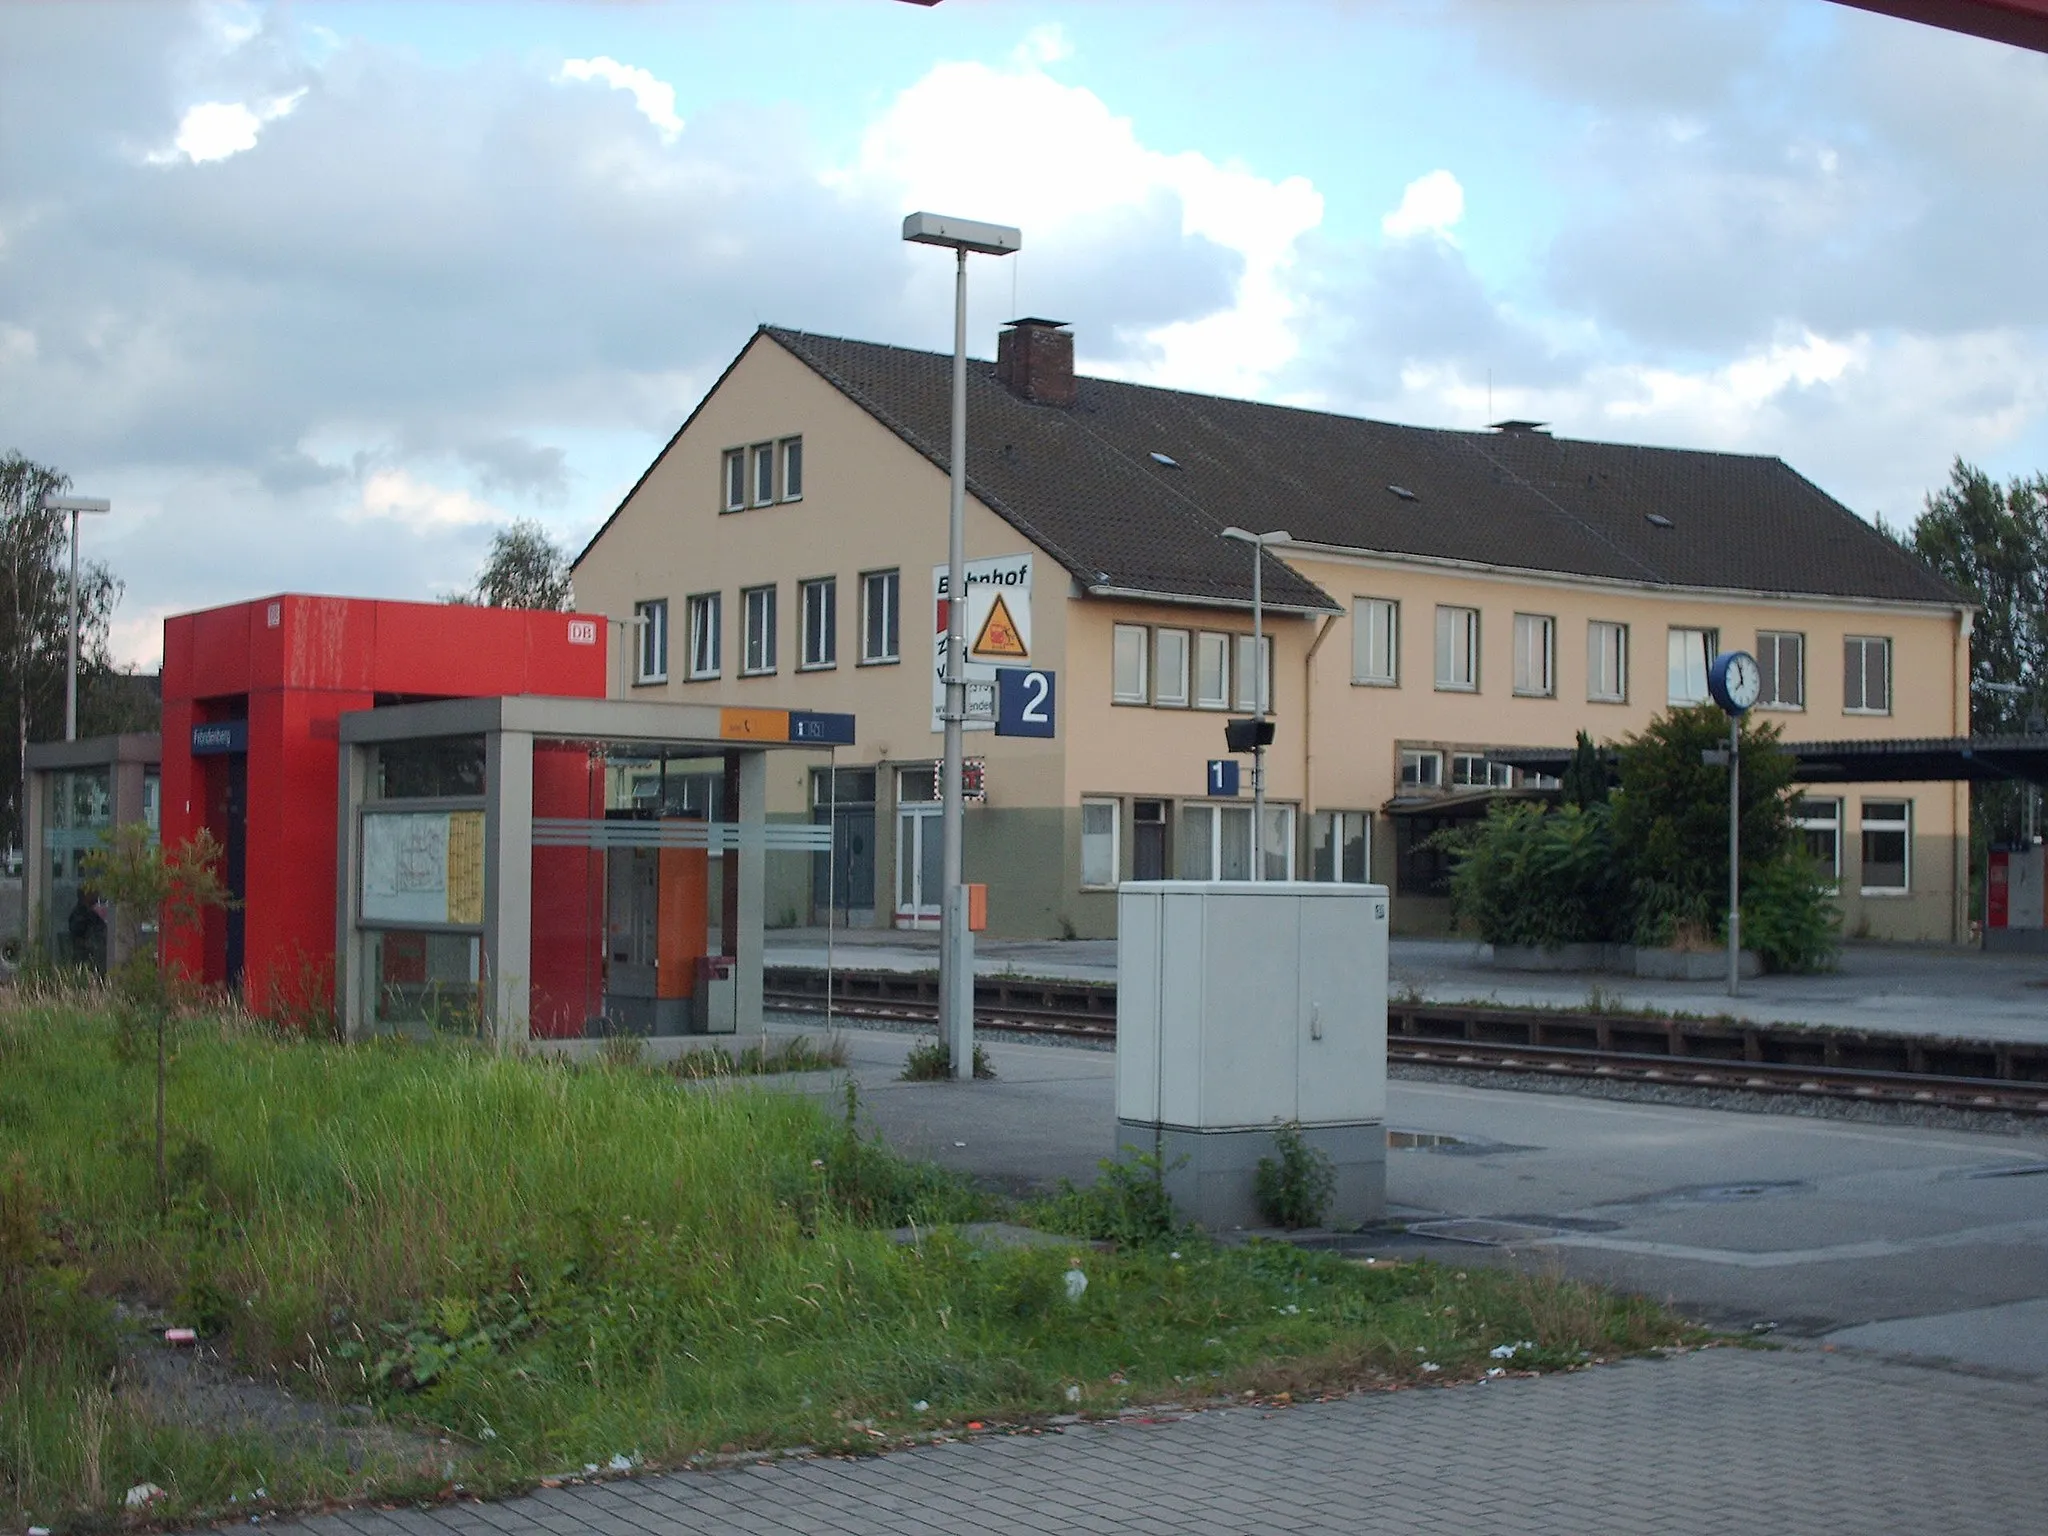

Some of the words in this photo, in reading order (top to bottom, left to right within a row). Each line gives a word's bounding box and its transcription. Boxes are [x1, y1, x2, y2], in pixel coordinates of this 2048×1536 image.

[937, 564, 1028, 594] Bhnhof
[572, 625, 592, 638] DB
[1022, 671, 1049, 723] 2
[1212, 761, 1223, 788] 1
